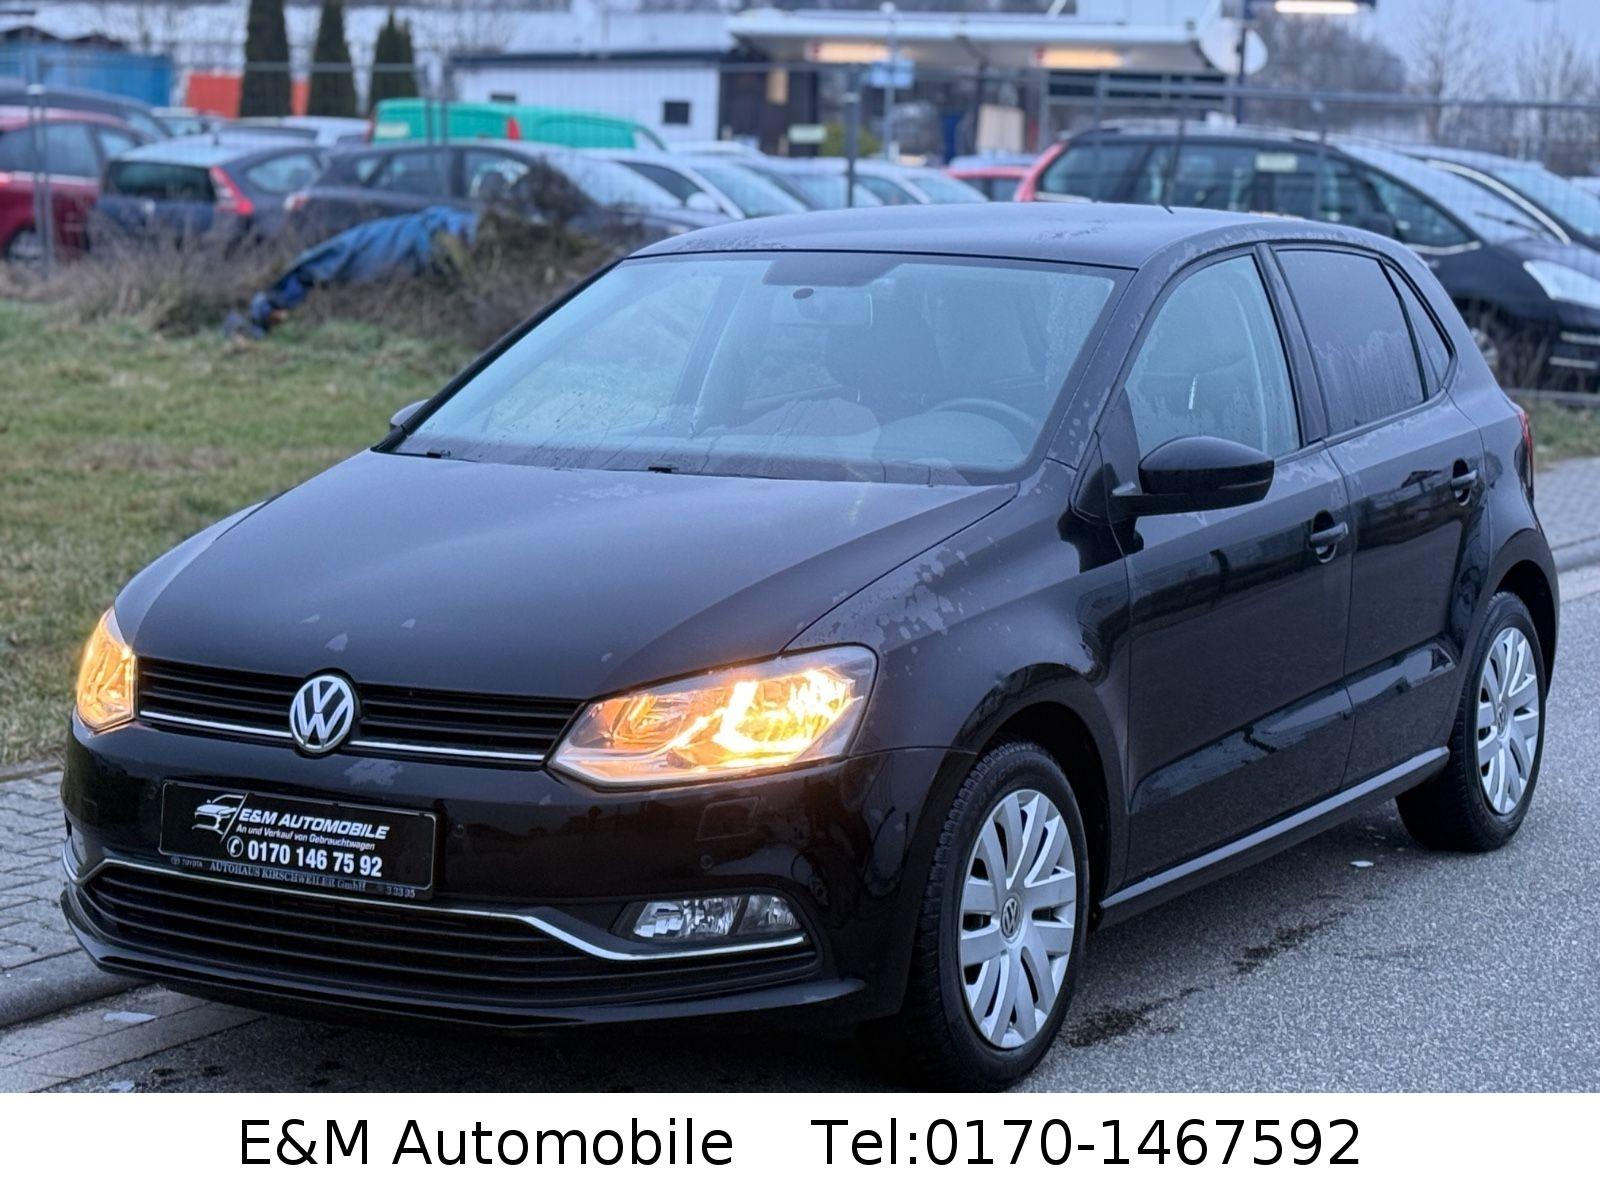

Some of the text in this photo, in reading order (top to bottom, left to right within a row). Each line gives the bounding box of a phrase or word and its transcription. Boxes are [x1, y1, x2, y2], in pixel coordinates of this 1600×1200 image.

[290, 675, 355, 753] VW
[236, 823, 375, 852] An und Verkauf von Gebrauchtwagen
[238, 807, 390, 840] E&M AUTOMOBILE
[247, 839, 383, 878] 0170 146 75 92
[209, 861, 261, 878] AUTOHAUS
[261, 868, 337, 887] KIRSCHWEILER
[337, 879, 367, 892] GmbH
